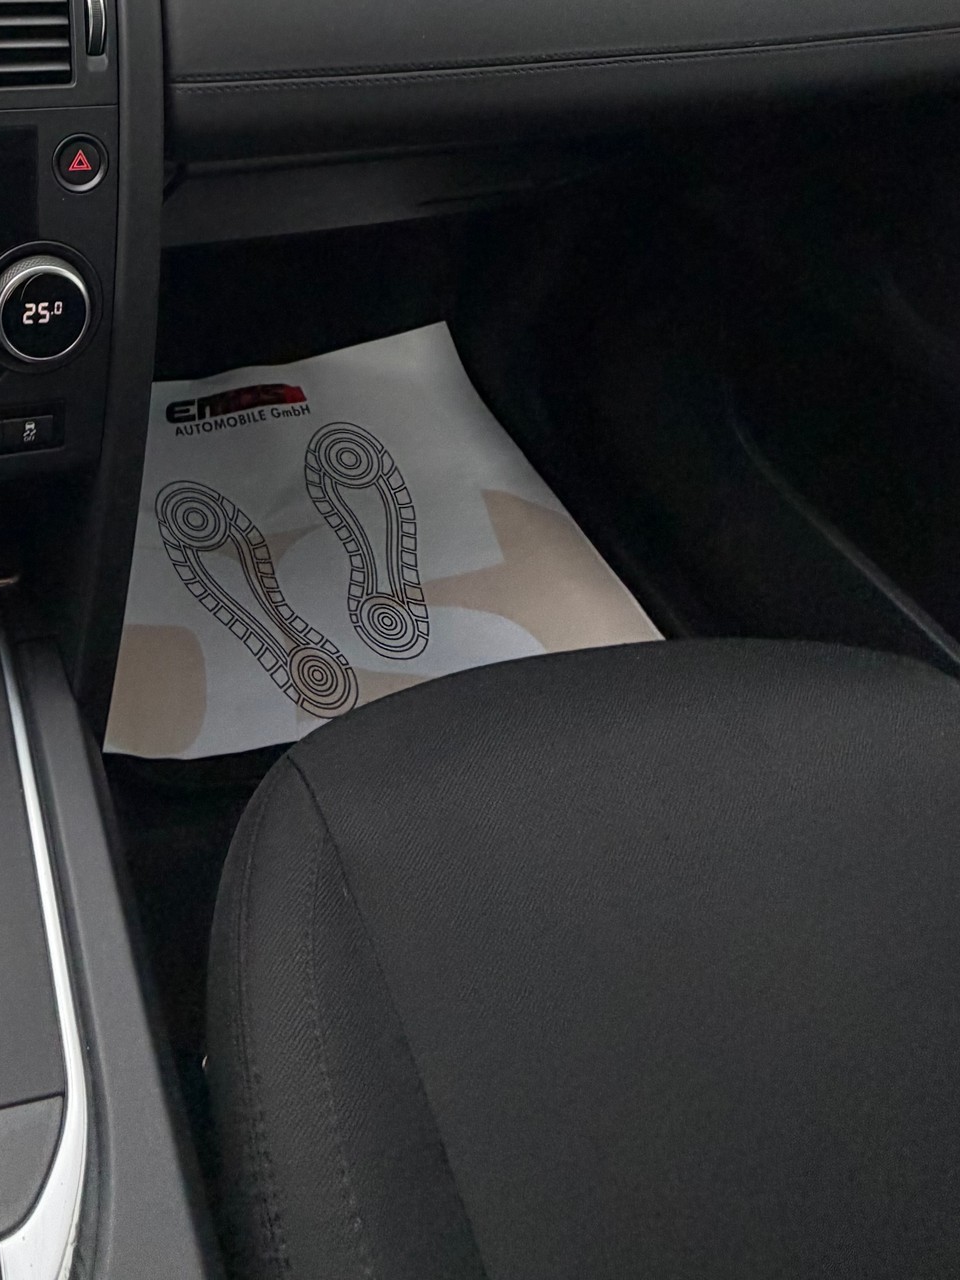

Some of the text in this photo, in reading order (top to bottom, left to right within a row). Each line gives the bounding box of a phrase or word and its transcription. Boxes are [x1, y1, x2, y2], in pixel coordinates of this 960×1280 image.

[22, 300, 63, 325] 25.0
[175, 404, 311, 437] AUTOMOBILE GmbH
